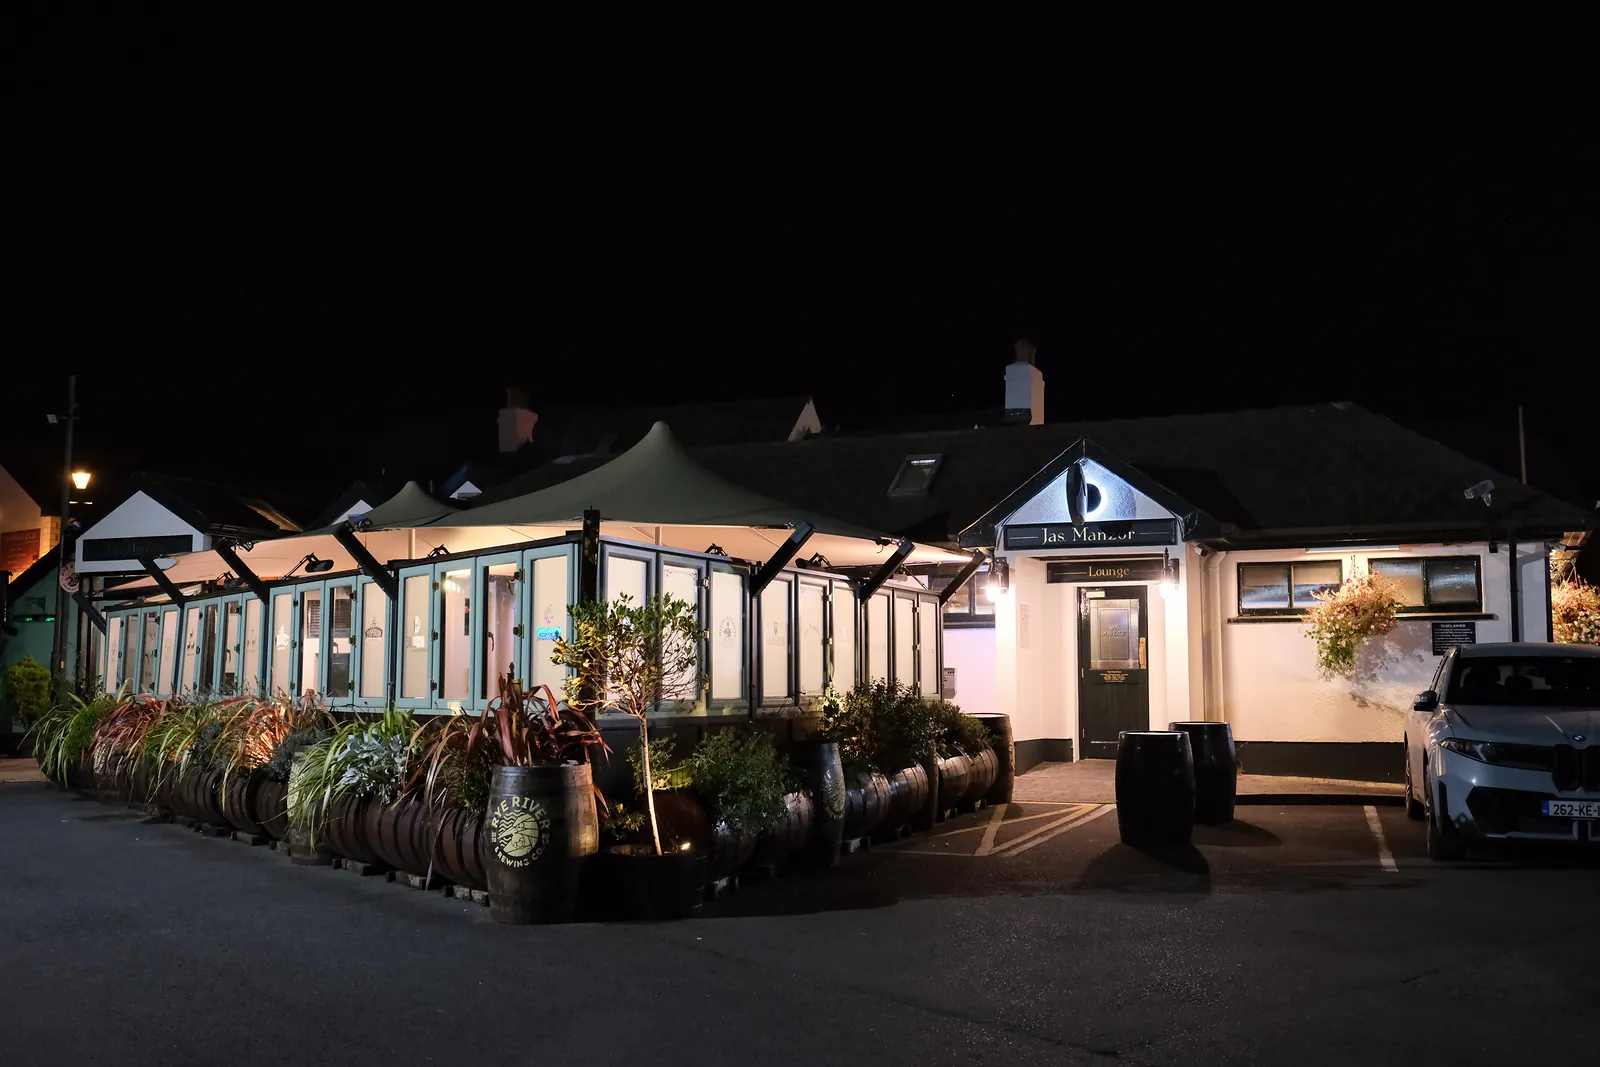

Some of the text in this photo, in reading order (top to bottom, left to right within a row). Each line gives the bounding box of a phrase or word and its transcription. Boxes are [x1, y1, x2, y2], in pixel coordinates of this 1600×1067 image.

[1088, 566, 1130, 578] Lounge
[491, 796, 551, 829] RYE RIVER
